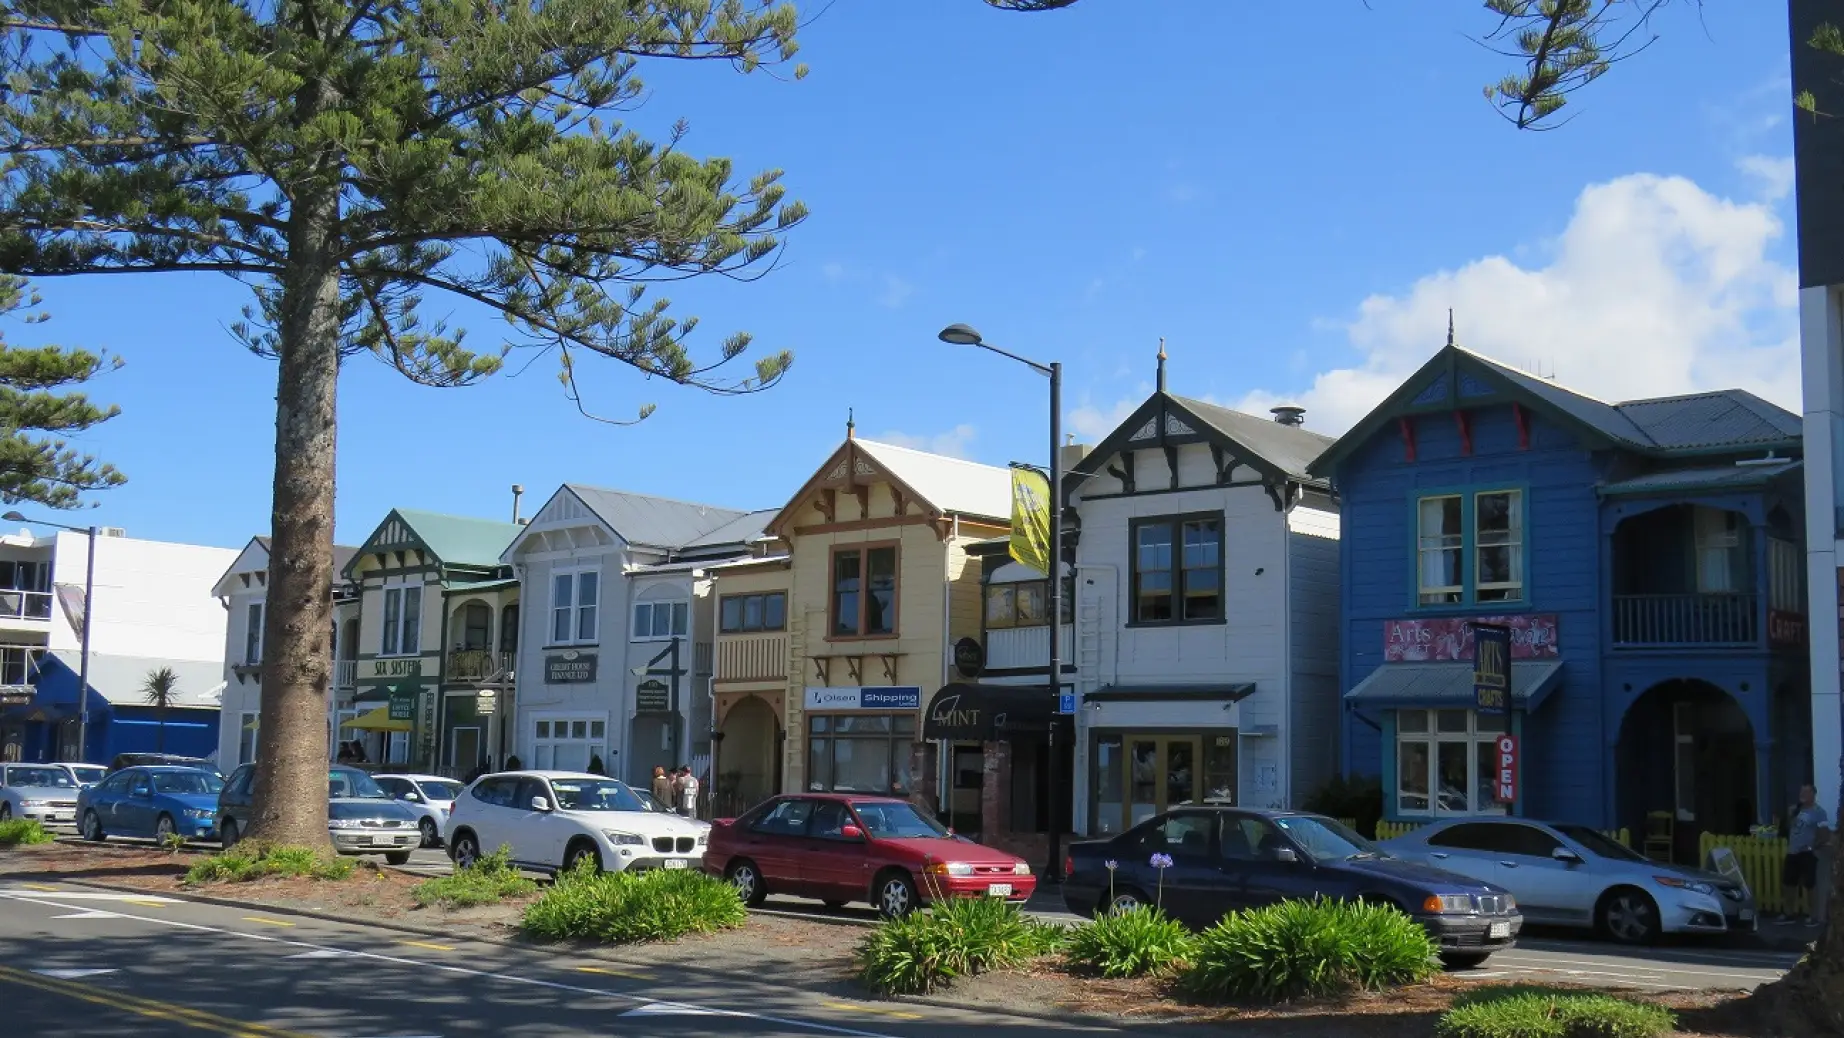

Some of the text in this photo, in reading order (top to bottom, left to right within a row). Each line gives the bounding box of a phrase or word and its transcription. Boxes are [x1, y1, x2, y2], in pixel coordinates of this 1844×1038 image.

[1388, 624, 1432, 643] Arts
[1479, 640, 1502, 674] ARTS
[374, 661, 387, 676] SIX
[572, 662, 591, 670] HOUSE
[551, 671, 589, 680] FINANCE LTD
[823, 693, 917, 703] Olsen Shipping
[1065, 695, 1071, 703] P
[1478, 689, 1503, 706] CRAFTS
[937, 709, 981, 726] MINT
[1215, 736, 1230, 747] 189
[1500, 738, 1513, 799] OPEN
